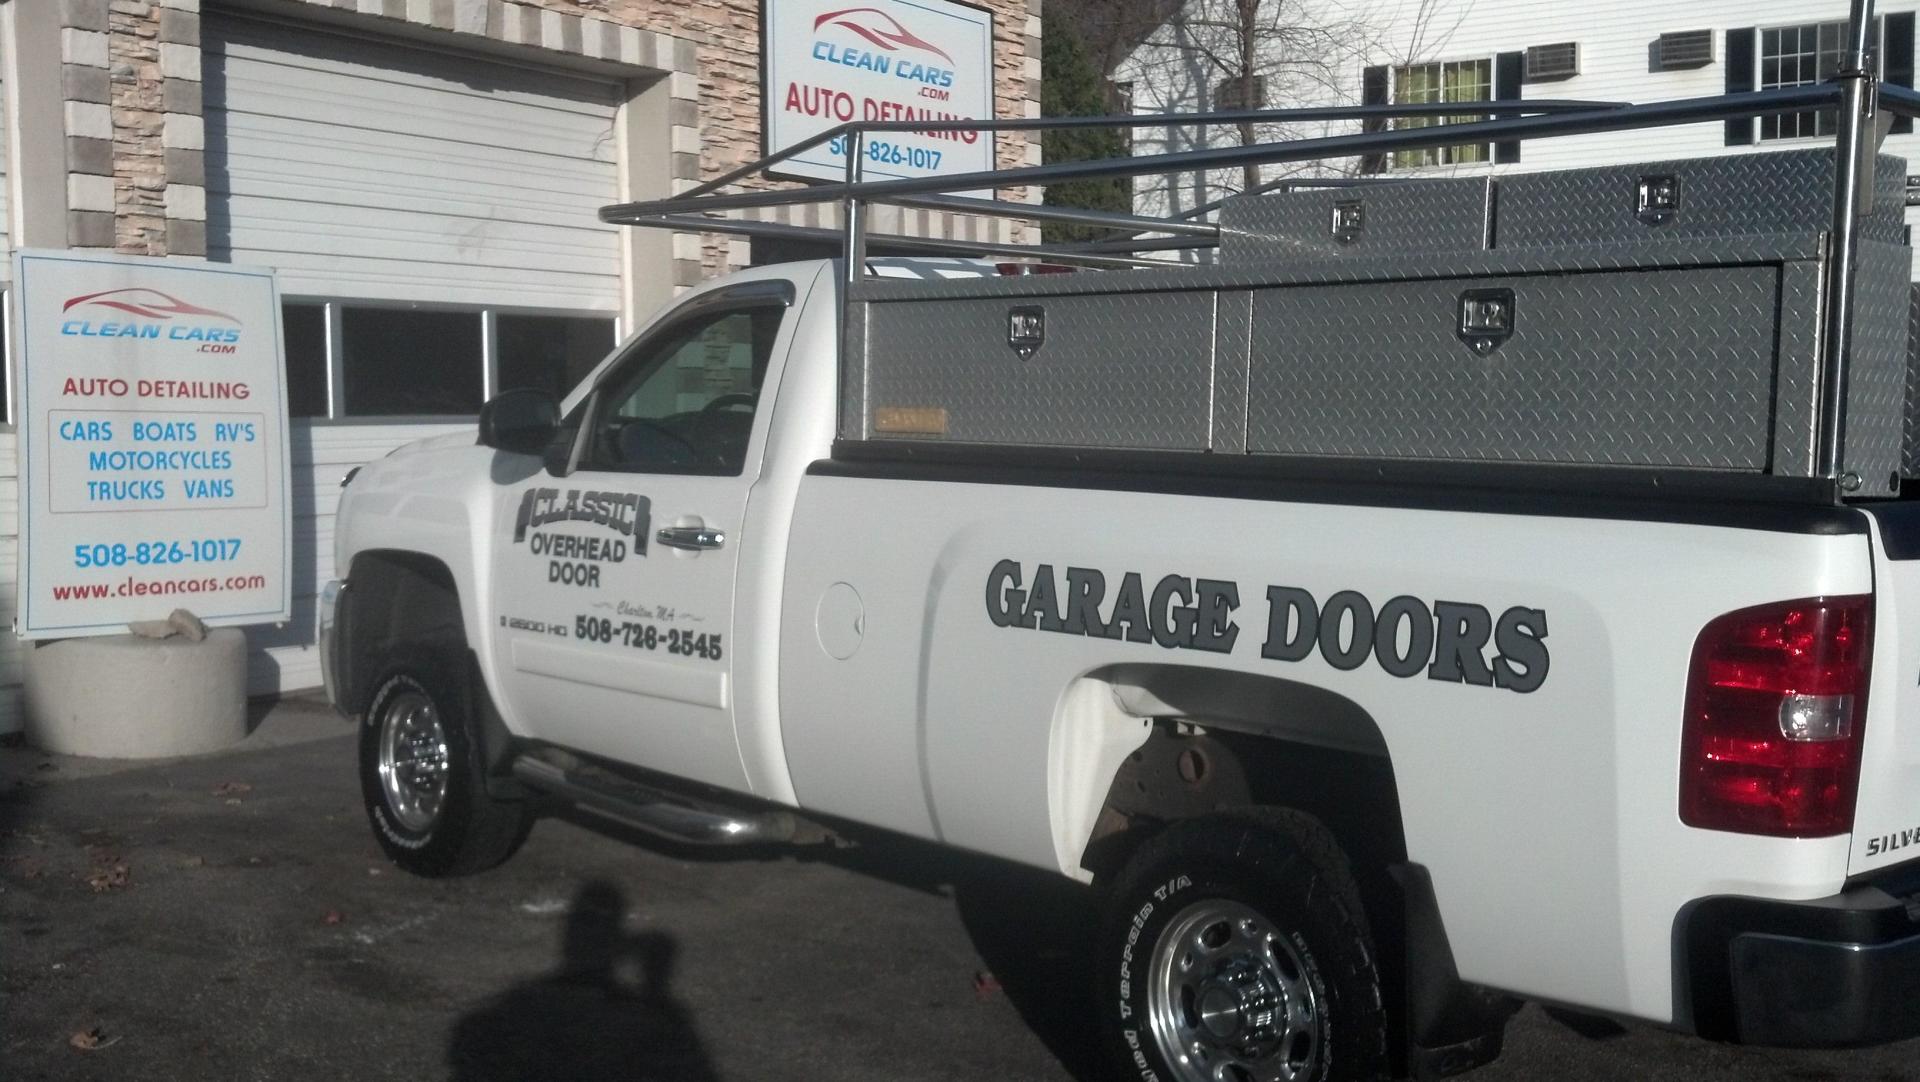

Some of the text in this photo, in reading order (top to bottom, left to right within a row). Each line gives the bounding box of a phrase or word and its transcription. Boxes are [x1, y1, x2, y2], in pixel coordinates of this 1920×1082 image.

[812, 41, 954, 88] CLEAN CARS
[785, 82, 855, 122] AUTO
[918, 86, 949, 101] .COM
[61, 320, 241, 343] CLEAN CARS
[196, 344, 236, 354] .COM
[63, 377, 250, 400] AUTO DETAILING
[60, 421, 255, 442] CARS BOATS RV'S
[89, 450, 231, 470] MOTORCYCLES
[87, 479, 234, 501] TRUCKS VANS
[531, 488, 639, 537] CLASSIC
[74, 539, 242, 568] 508-826-1017
[531, 533, 626, 563] OVERHEAD
[549, 561, 600, 588] DOOR
[53, 575, 265, 601] www.cleancars.com
[985, 558, 1550, 694] GARAGE DOORS
[1154, 874, 1192, 901] T/A
